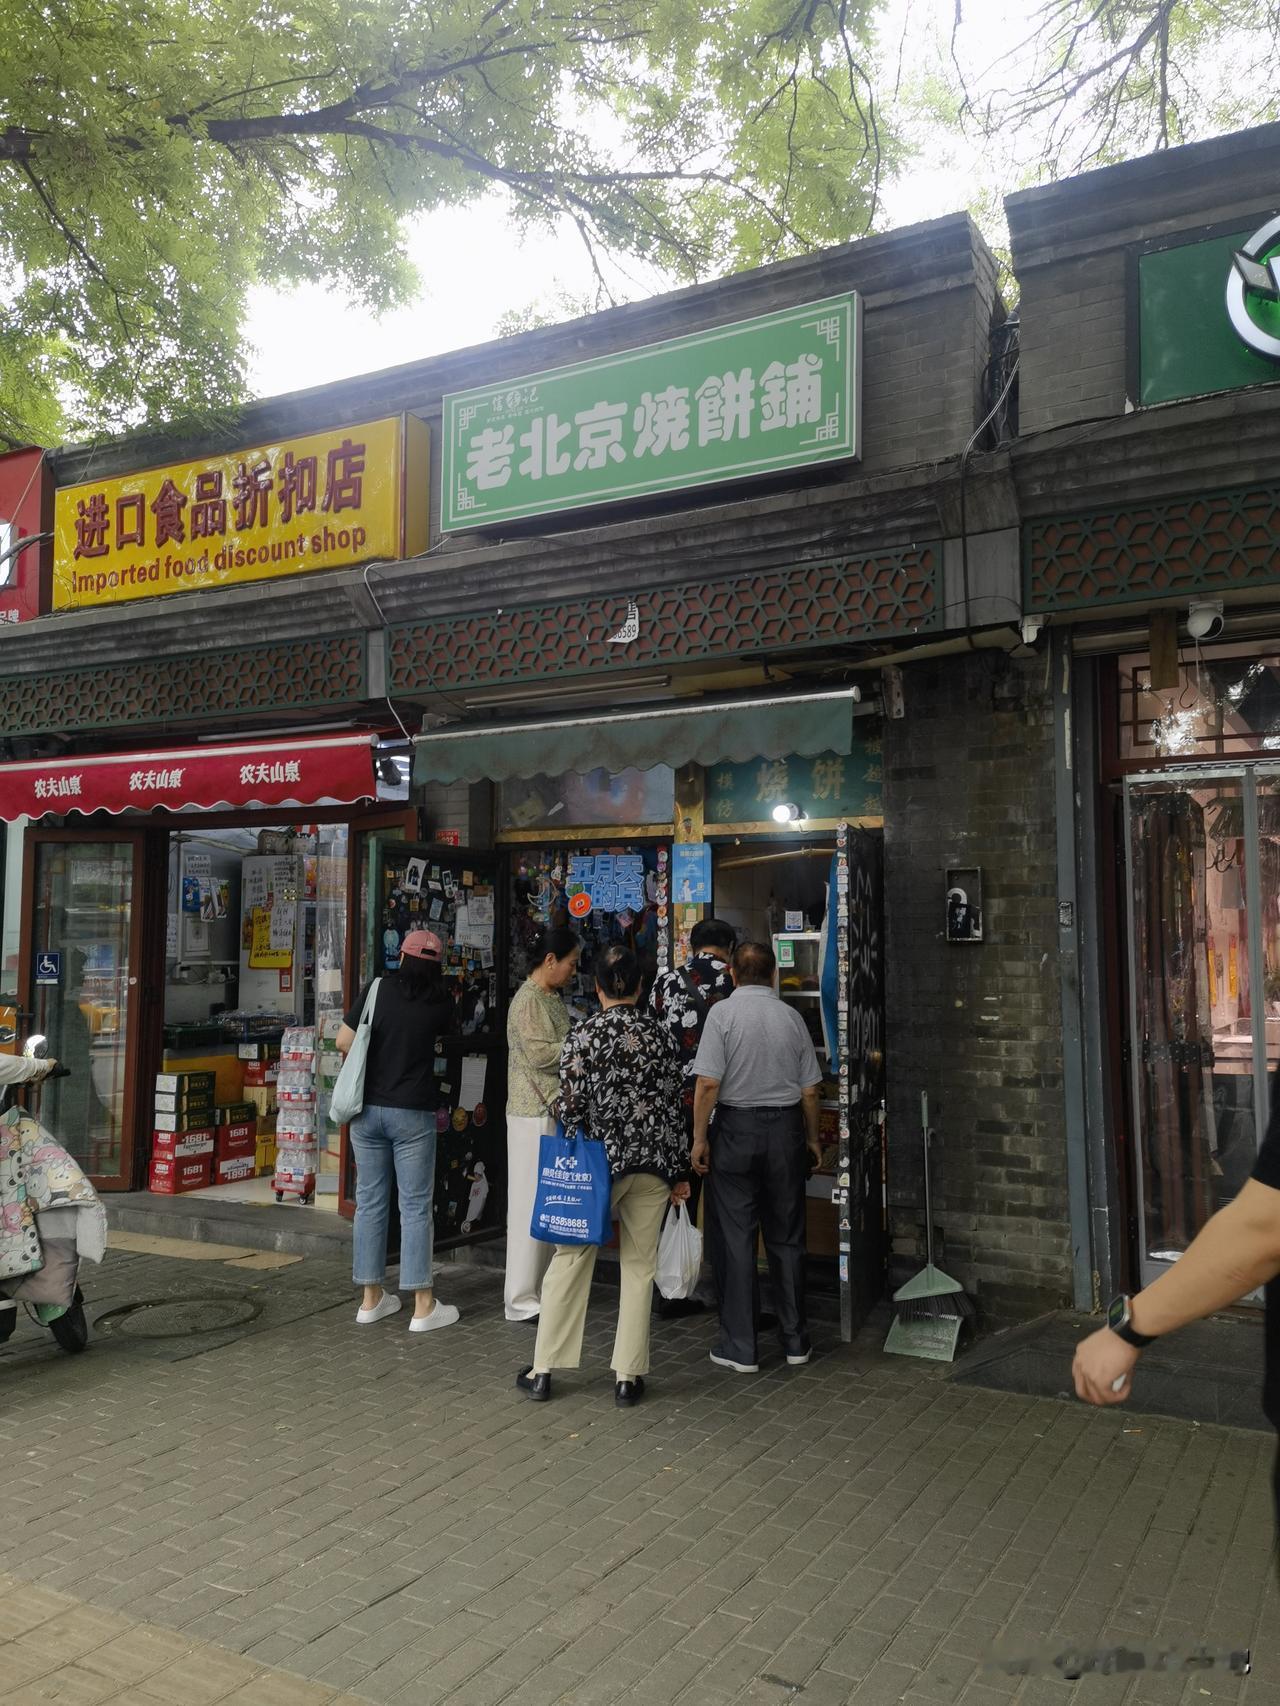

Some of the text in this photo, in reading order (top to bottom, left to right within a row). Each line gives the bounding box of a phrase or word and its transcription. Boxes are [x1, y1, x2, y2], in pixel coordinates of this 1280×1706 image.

[466, 353, 823, 491] 老北京燒餅鋪
[73, 439, 367, 560] 进口食品折扣店
[72, 525, 367, 595] Imported food discount shop
[129, 768, 185, 791] 农夫山泉
[239, 760, 301, 784] 农夫山泉
[34, 774, 82, 798] 农夫山泉
[568, 854, 645, 884] 五月天
[184, 1133, 207, 1144] 1681
[229, 1127, 248, 1138] 1681
[183, 1165, 202, 1176] 1681
